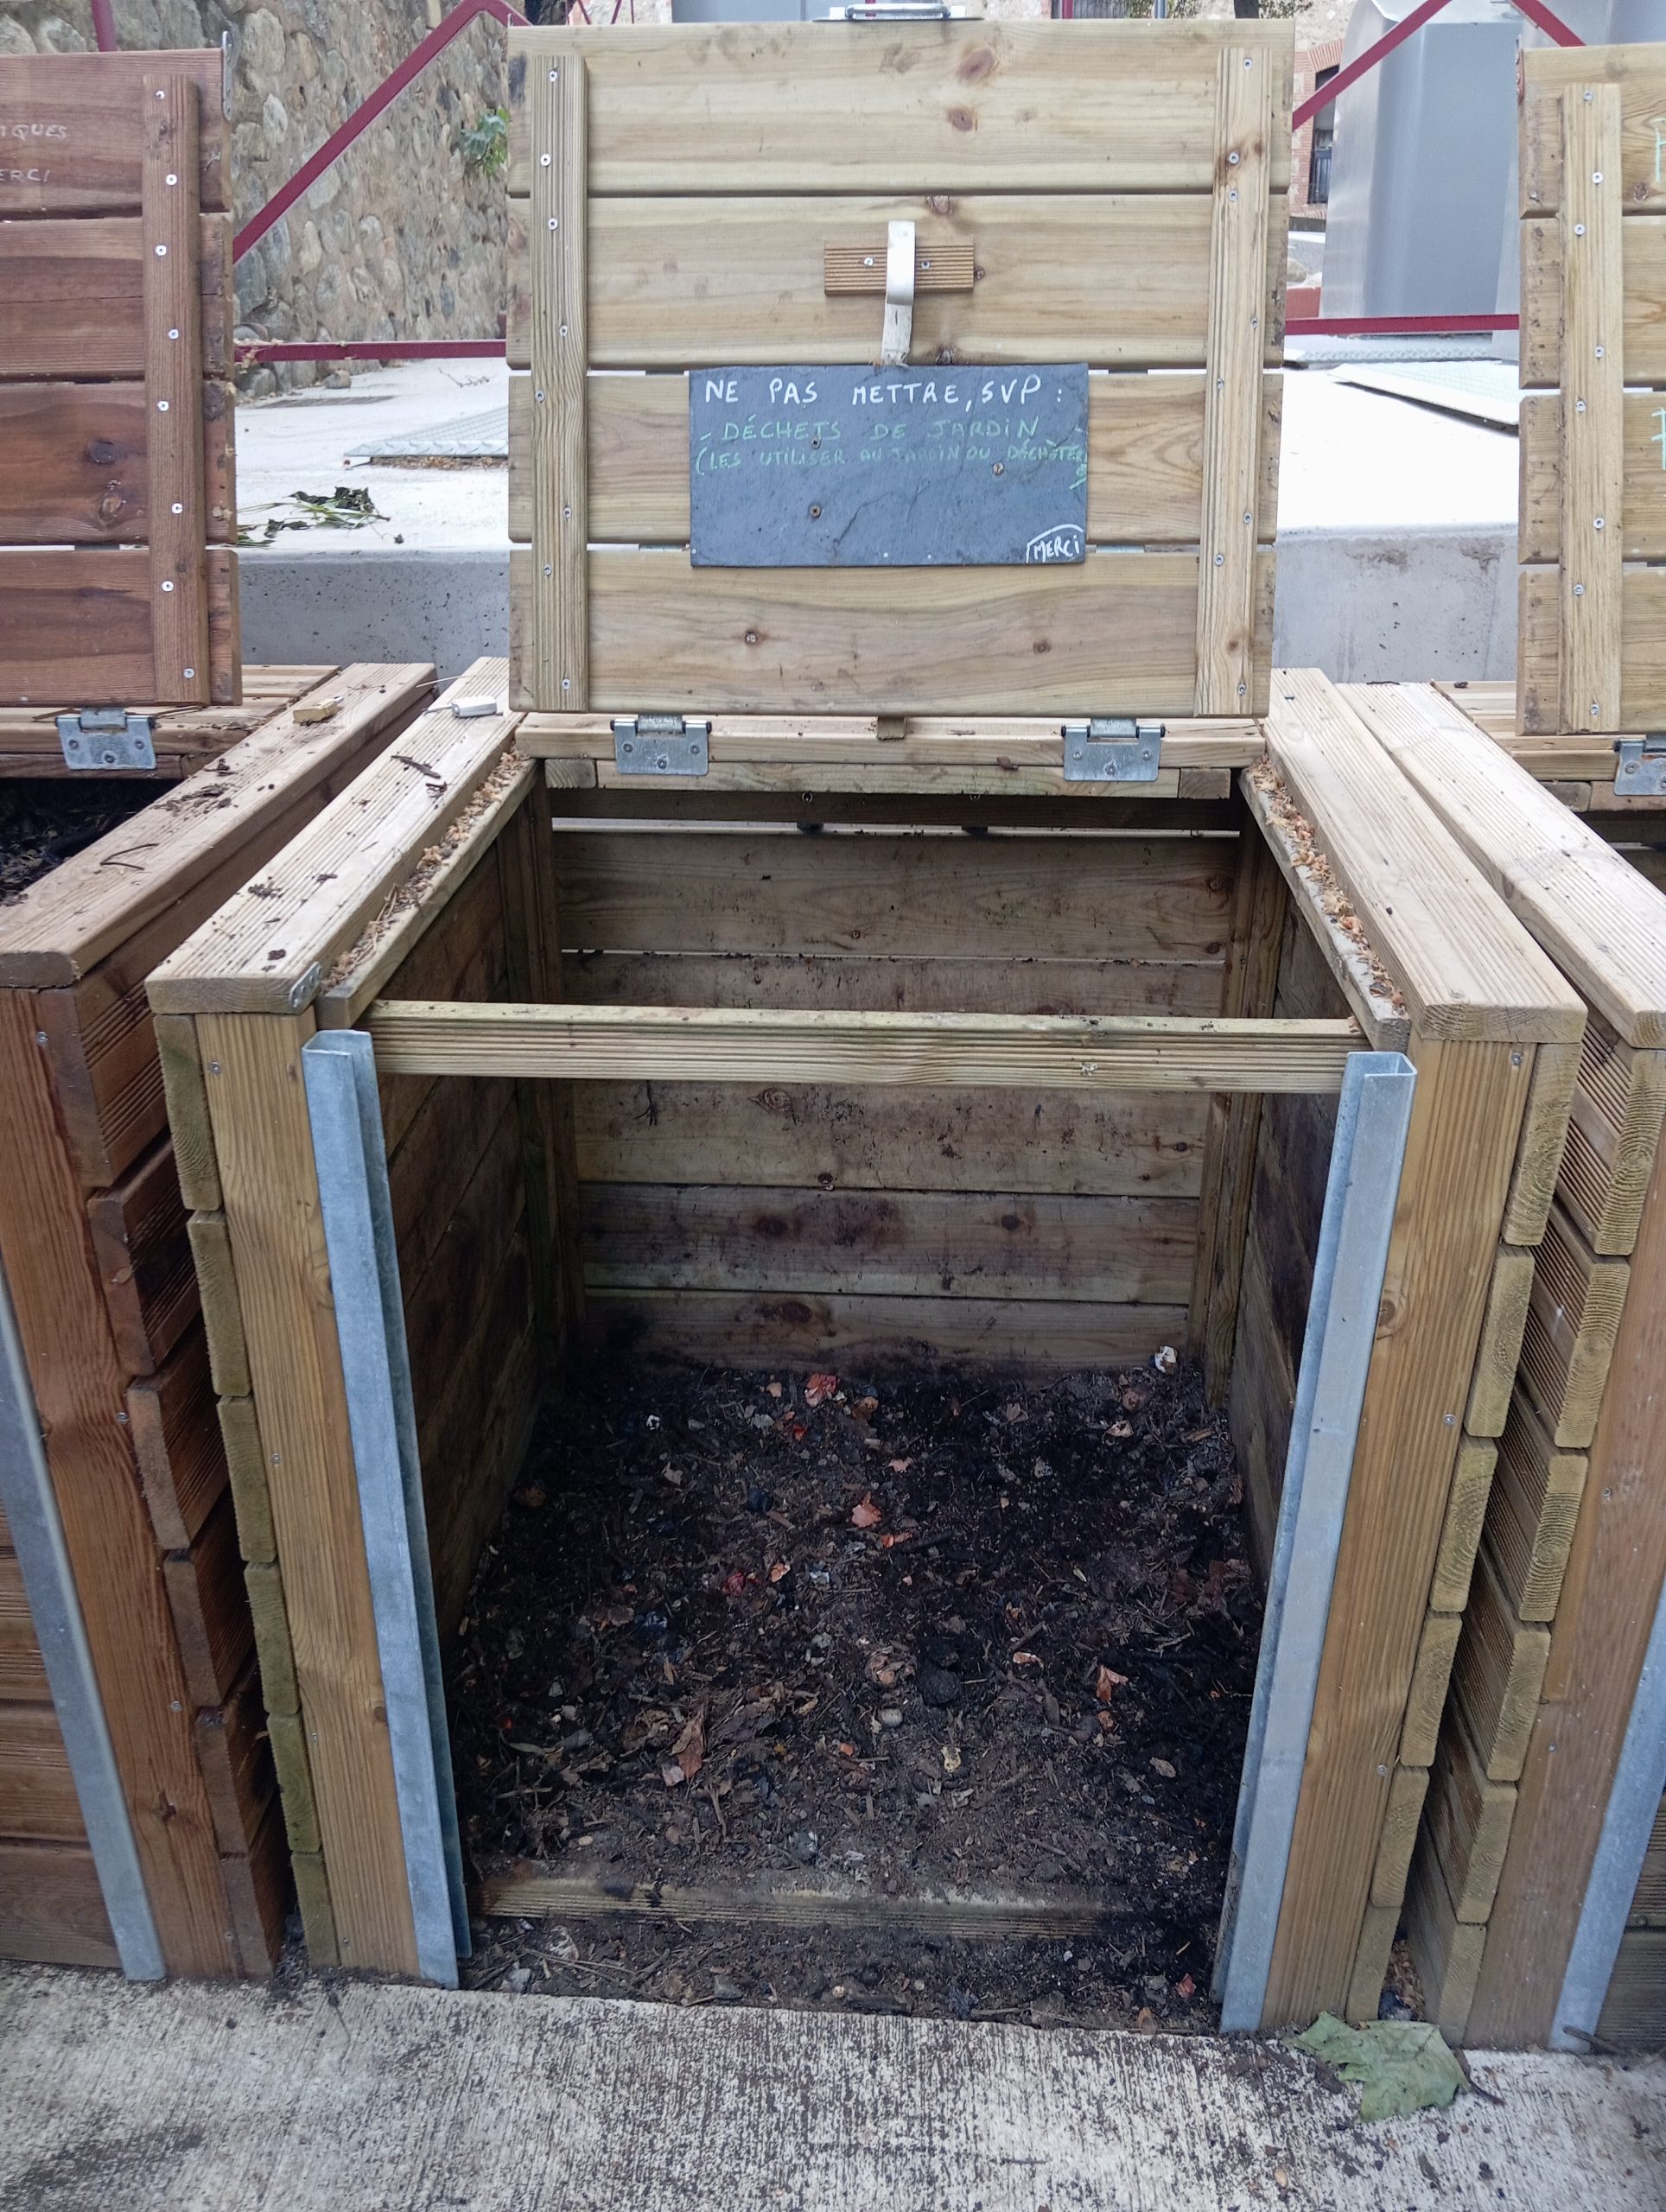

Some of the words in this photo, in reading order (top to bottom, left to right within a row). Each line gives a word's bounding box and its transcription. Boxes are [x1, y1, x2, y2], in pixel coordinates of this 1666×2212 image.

[704, 379, 739, 404] NE
[768, 378, 818, 408] PAS
[870, 423, 906, 440] DE
